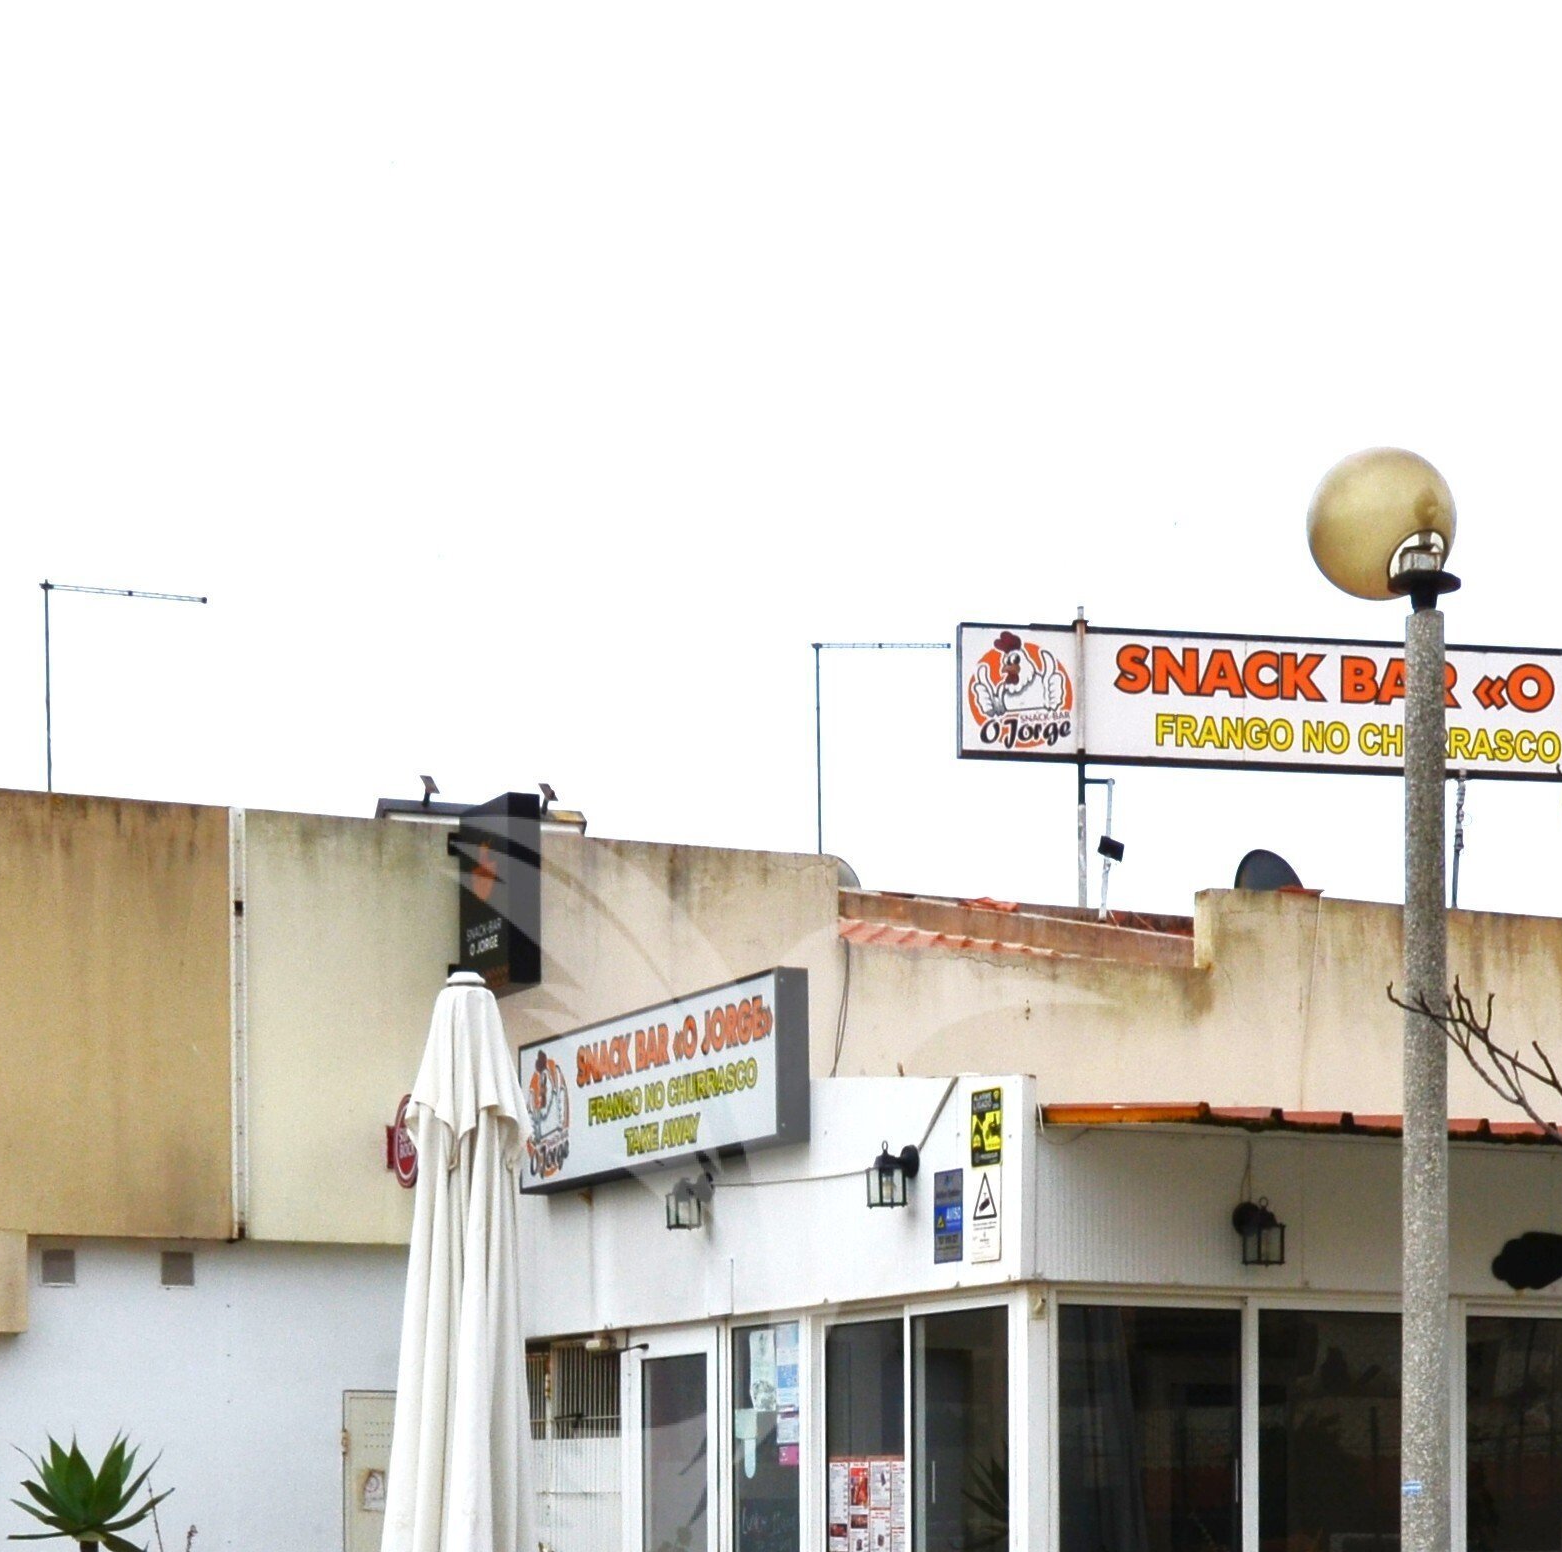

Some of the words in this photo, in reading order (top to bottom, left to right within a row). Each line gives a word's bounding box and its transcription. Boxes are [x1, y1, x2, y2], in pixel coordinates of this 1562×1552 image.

[1113, 643, 1328, 702] SNACK
[980, 718, 1001, 744] O
[1003, 717, 1072, 749] Jorge
[1154, 713, 1294, 753] FRANGO
[1301, 718, 1351, 756] NO
[1358, 722, 1561, 766] CHRASCO
[469, 943, 476, 957] O
[476, 934, 499, 955] JORGE
[576, 1035, 631, 1089] SNACK
[635, 1023, 671, 1069] BAR
[587, 1083, 643, 1127] FRANGO
[644, 1079, 666, 1114] NO
[666, 1056, 759, 1108] CHURRASCO
[623, 1121, 660, 1159] TAKE
[659, 1112, 700, 1151] AWAY
